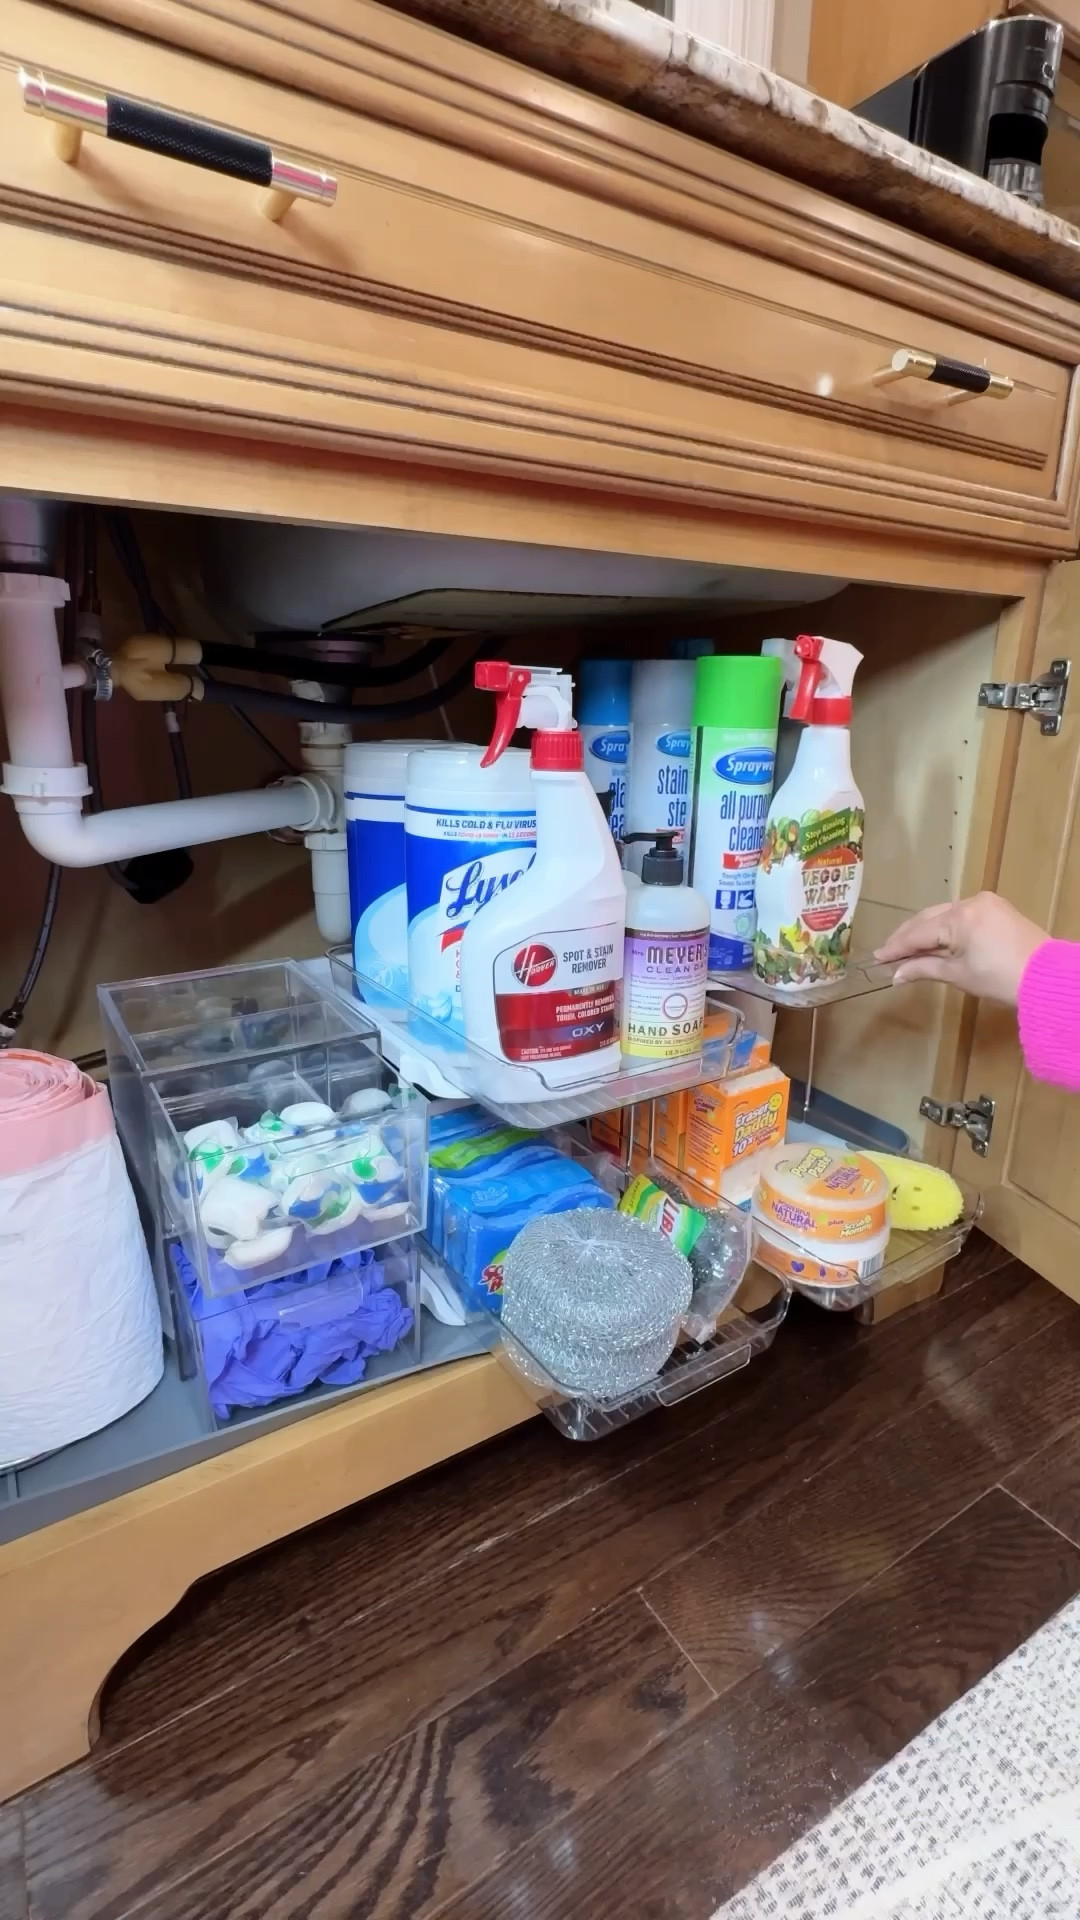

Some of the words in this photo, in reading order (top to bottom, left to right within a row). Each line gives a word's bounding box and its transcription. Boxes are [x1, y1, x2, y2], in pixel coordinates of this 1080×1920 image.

[657, 765, 688, 795] stain
[667, 798, 687, 827] ste
[720, 790, 737, 820] all
[436, 818, 460, 829] KILLS
[462, 819, 486, 829] COLD
[487, 820, 493, 829] &
[496, 820, 514, 829] FLU
[515, 819, 536, 829] VIRUS
[817, 855, 843, 865] Natural
[801, 865, 856, 887] VEGGIE
[804, 884, 848, 906] WASH
[563, 950, 585, 963] SPOT
[587, 947, 592, 959] &
[595, 943, 614, 958] STAIN
[572, 958, 607, 974] REMOVER
[646, 964, 690, 974] CLEAN
[556, 1000, 594, 1014] PERMANENTLY
[577, 1006, 600, 1019] COLORED
[572, 1021, 605, 1038] OXY
[628, 1022, 668, 1037] HAND
[735, 1103, 770, 1127] Eraser
[735, 1110, 779, 1143] Daddy
[772, 1201, 815, 1228] NATURAL
